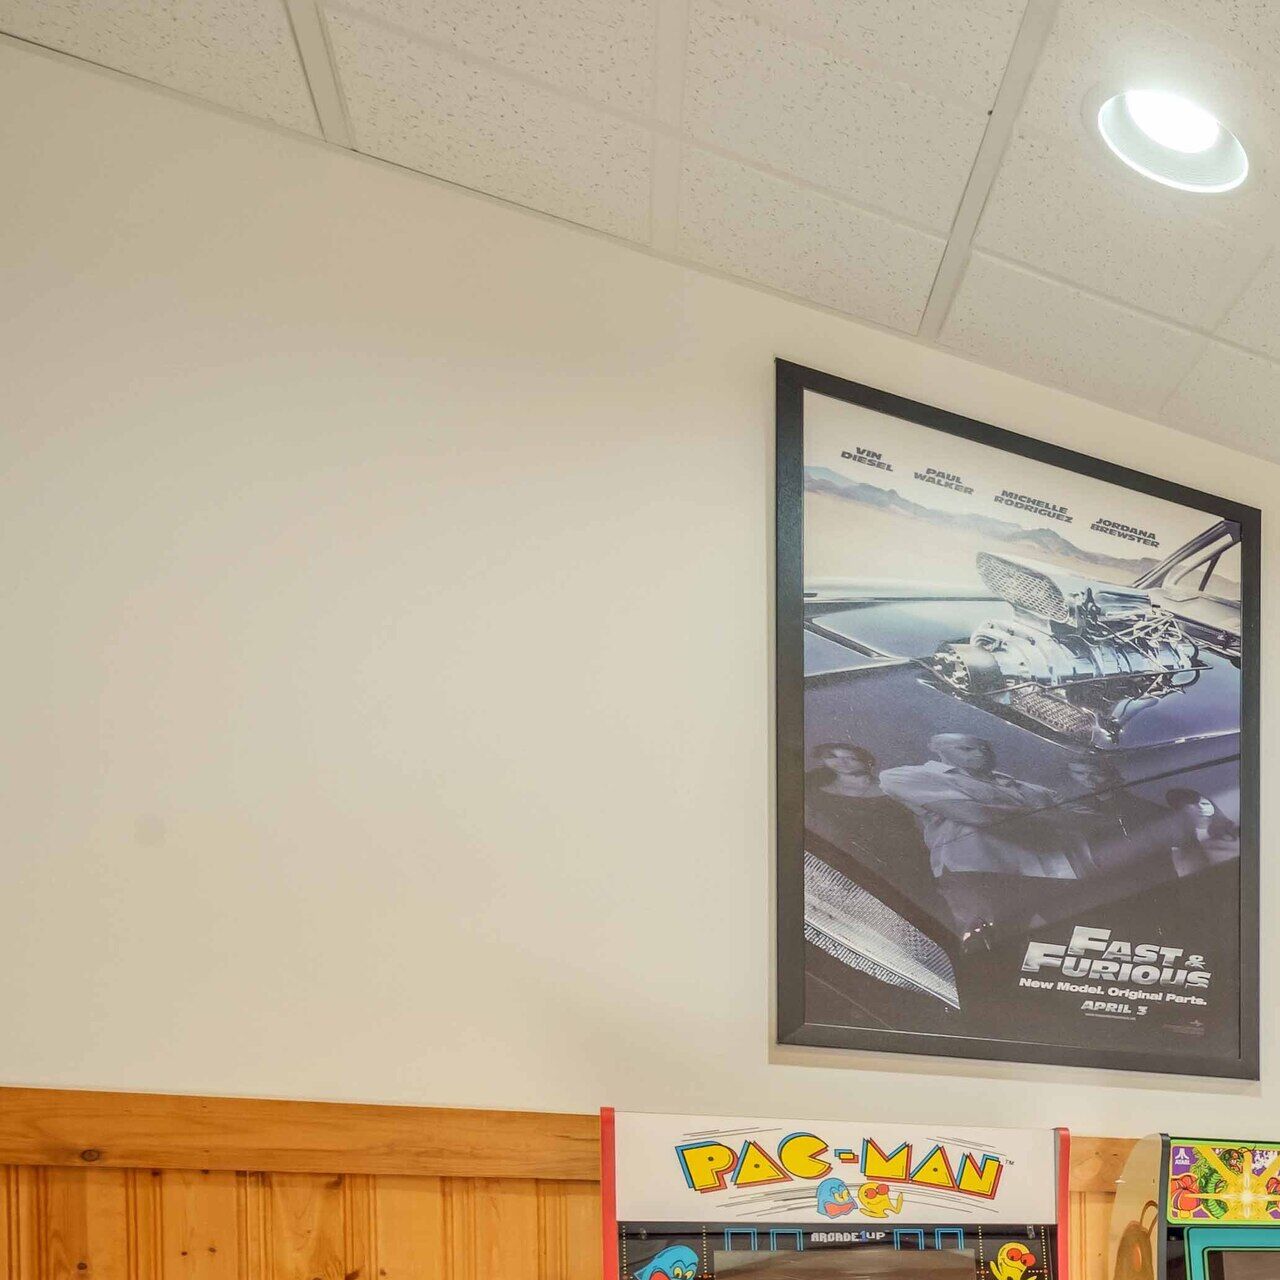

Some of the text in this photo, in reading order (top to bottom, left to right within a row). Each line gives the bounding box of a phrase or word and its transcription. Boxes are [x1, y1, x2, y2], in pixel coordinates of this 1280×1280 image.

[841, 451, 894, 472] DIESEL
[855, 446, 883, 461] VIN
[913, 471, 974, 496] WALKER
[926, 467, 963, 485] PAUL
[993, 495, 1074, 524] RODRIGUEZ
[1001, 490, 1068, 515] MICHELLE
[1090, 523, 1160, 549] BREWSTER
[1095, 518, 1157, 541] JORDANA
[1184, 954, 1205, 969] &
[1019, 977, 1207, 1006] New Model. Original Parts.
[1081, 1001, 1148, 1016] APRIL 3
[674, 1131, 1003, 1200] PAC-MAN
